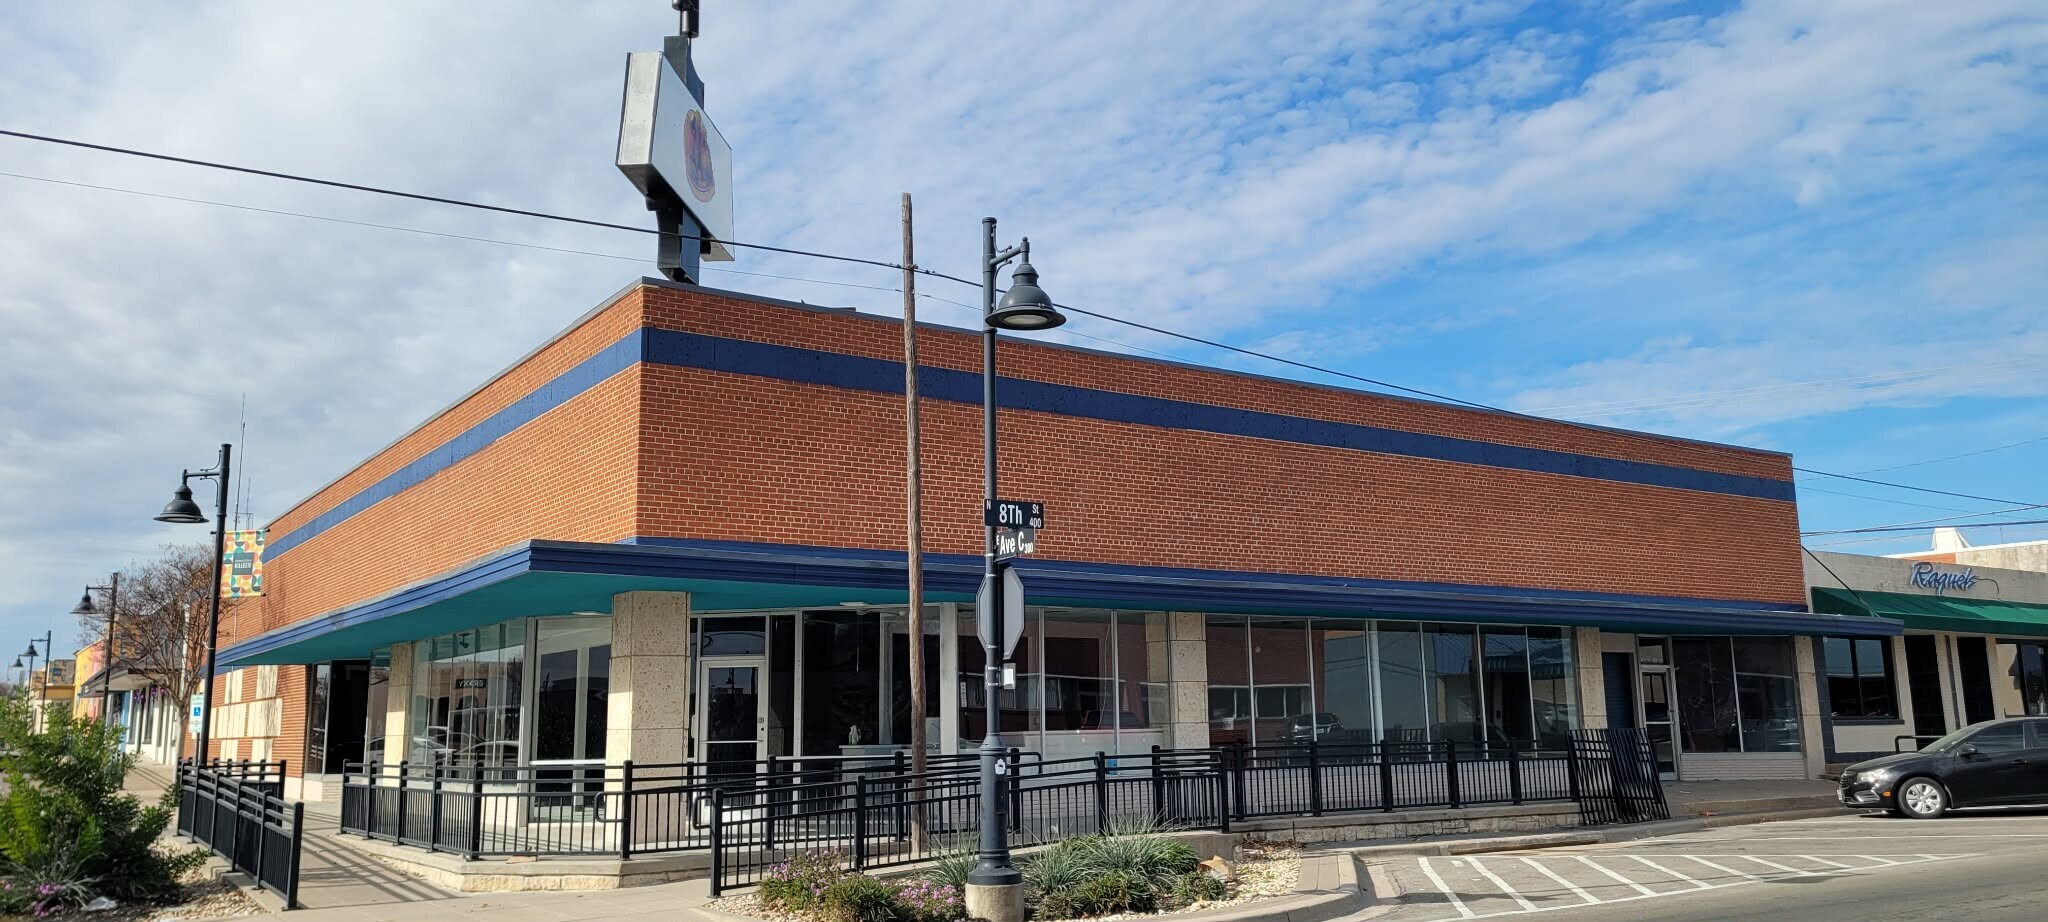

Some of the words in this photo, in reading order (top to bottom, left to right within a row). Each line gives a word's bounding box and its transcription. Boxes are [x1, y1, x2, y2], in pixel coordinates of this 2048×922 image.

[986, 500, 992, 510] N
[999, 503, 1022, 525] 8Th
[1032, 504, 1039, 514] St
[1029, 517, 1041, 528] 400
[996, 535, 1000, 546] E
[999, 536, 1015, 555] Ave
[1018, 531, 1024, 551] C
